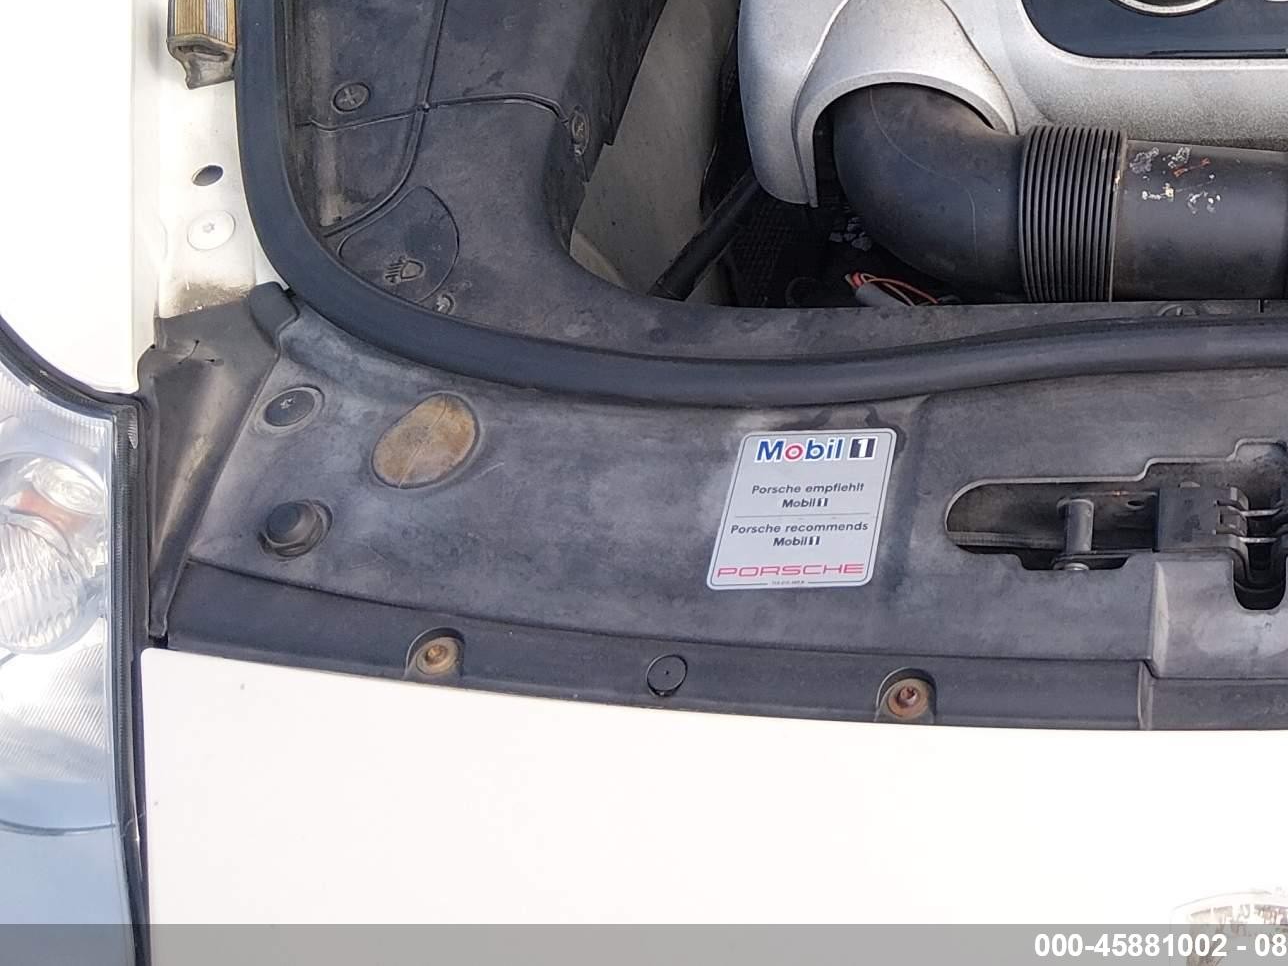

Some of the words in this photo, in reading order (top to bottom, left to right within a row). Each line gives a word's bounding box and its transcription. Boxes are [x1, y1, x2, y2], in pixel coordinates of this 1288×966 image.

[755, 438, 844, 461] Mobil
[850, 438, 876, 459] 1
[752, 484, 800, 494] Porsche
[805, 483, 865, 494] empfiehlt
[782, 498, 815, 508] Mobil
[730, 524, 781, 534] Porsche
[785, 521, 868, 533] recommends
[773, 537, 808, 546] Mobil
[717, 564, 864, 578] PORSCHE
